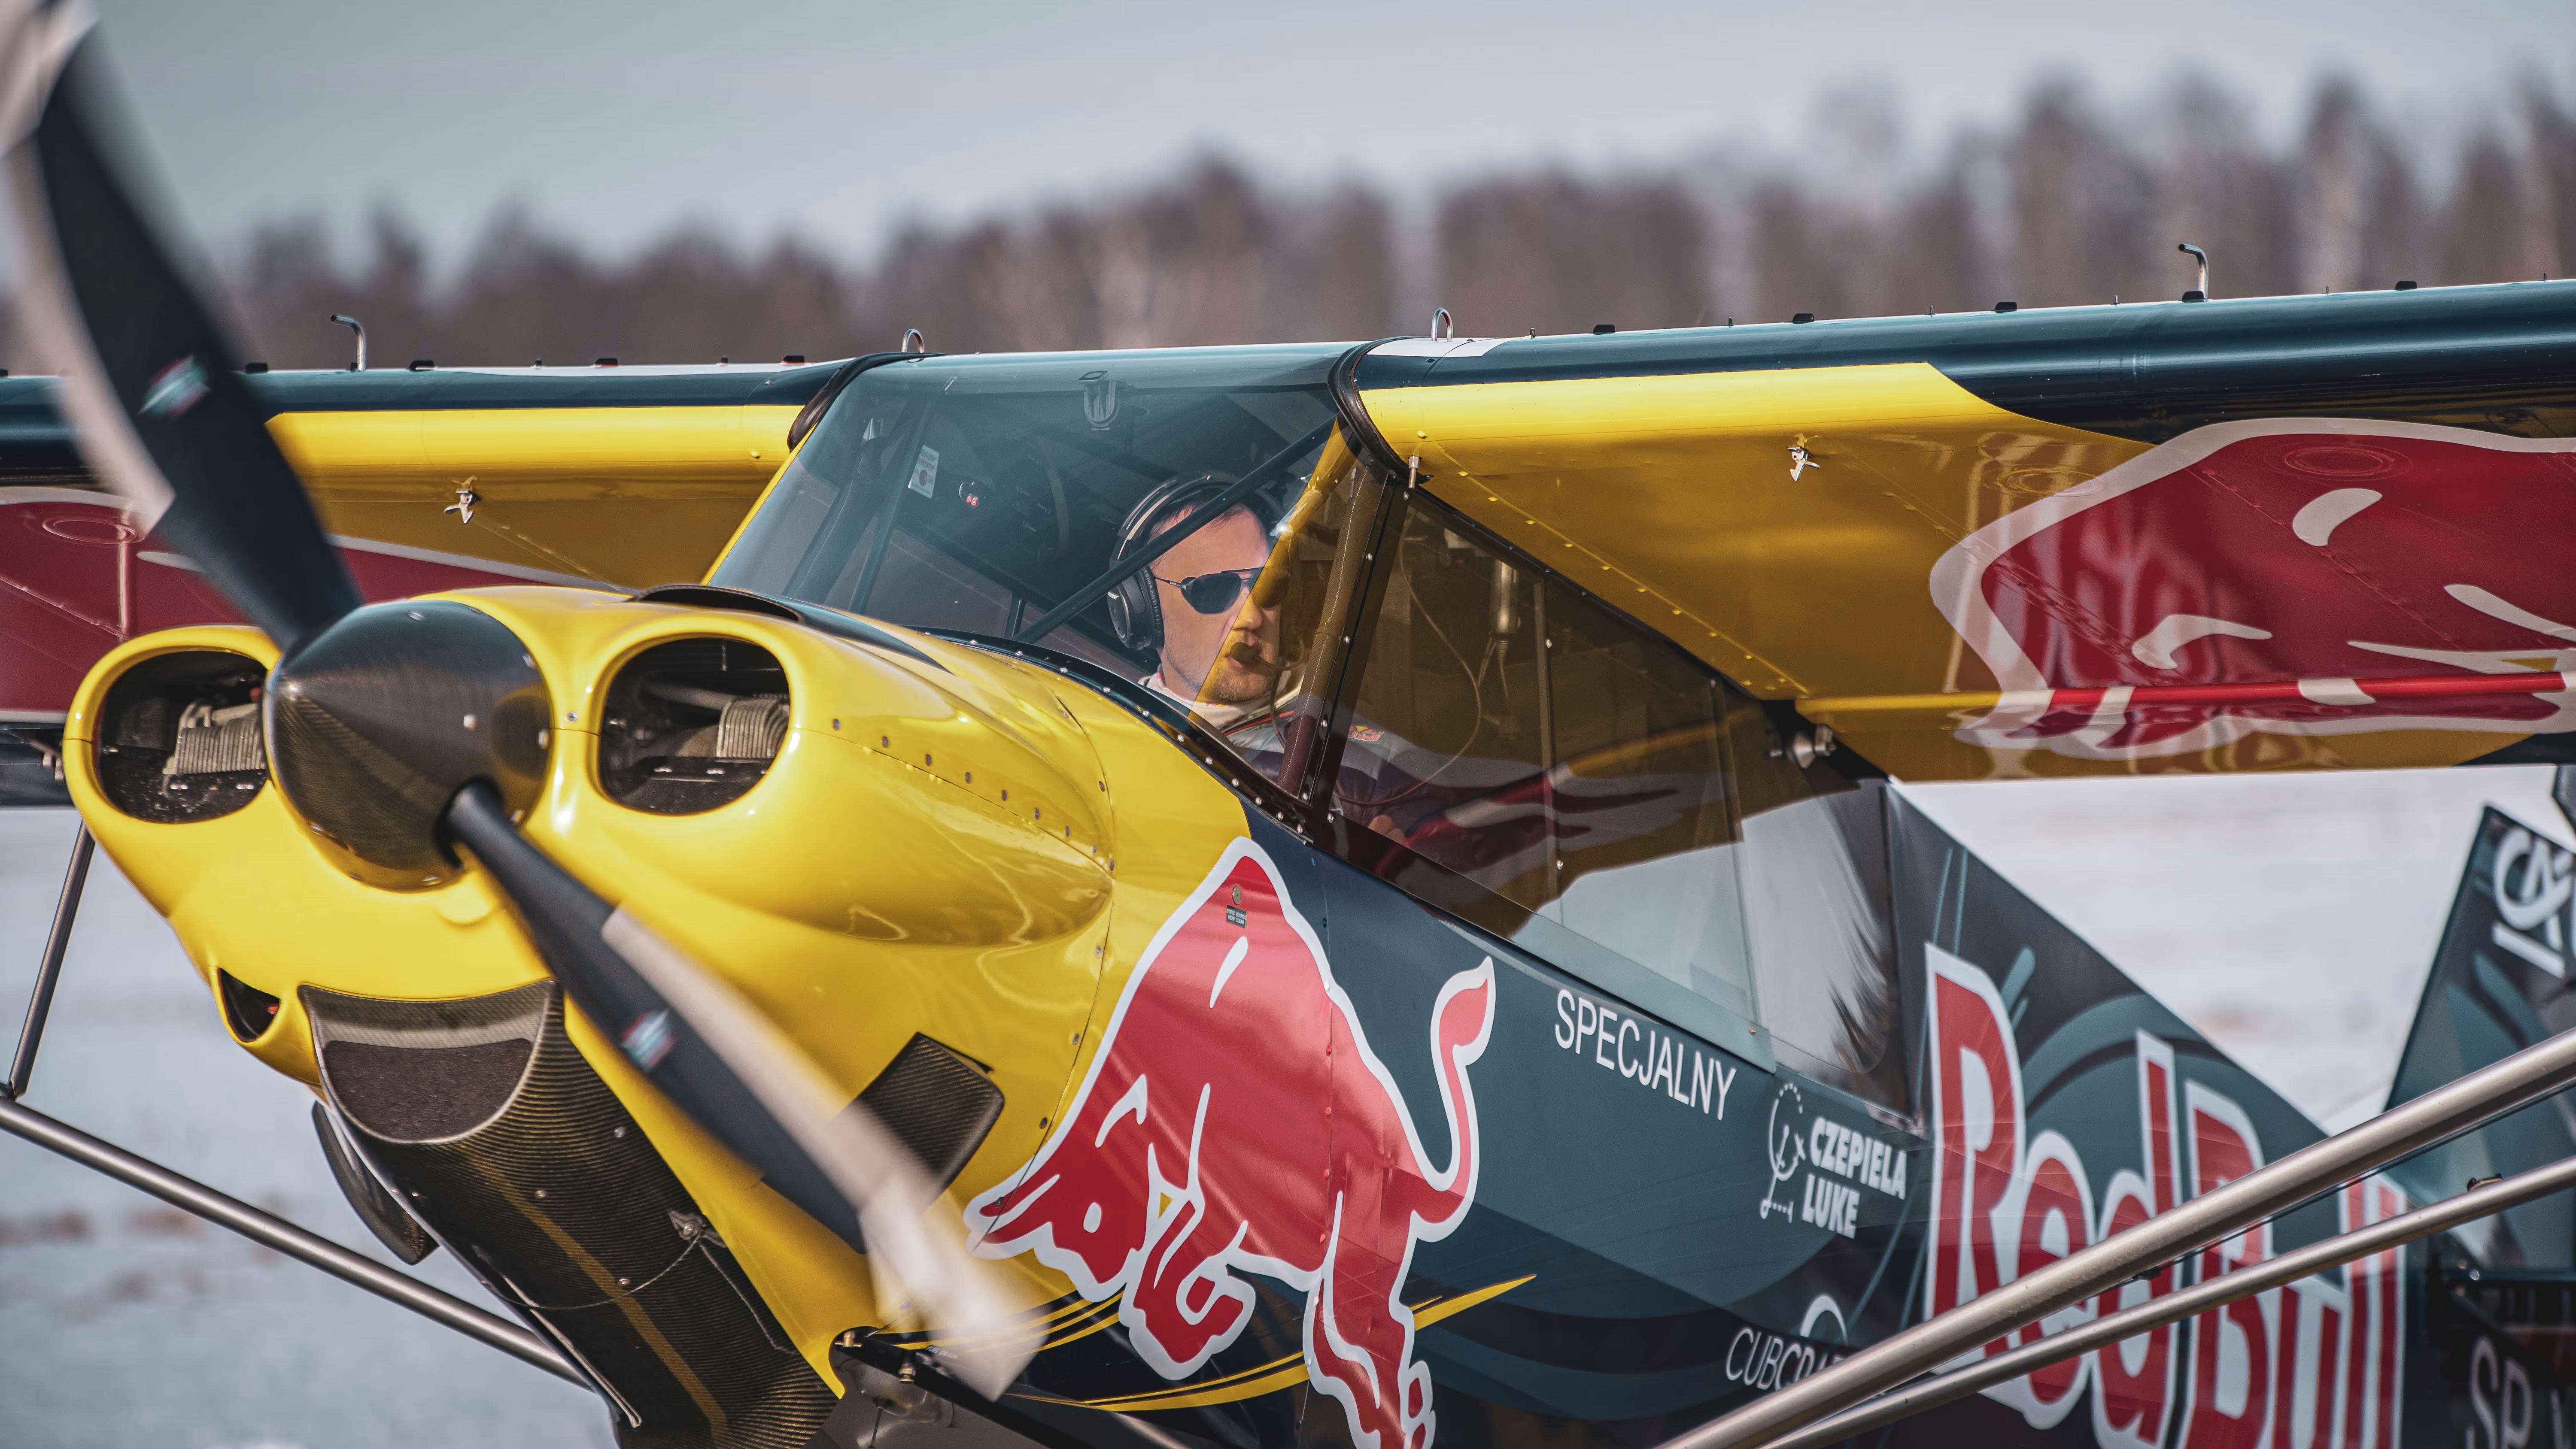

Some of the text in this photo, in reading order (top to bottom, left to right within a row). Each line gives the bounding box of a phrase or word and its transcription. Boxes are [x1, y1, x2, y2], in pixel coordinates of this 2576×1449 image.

[1555, 989, 1737, 1121] SPECJALNY
[1810, 1117, 1907, 1200] CZEPIELA
[1802, 1173, 1860, 1240] LUKE
